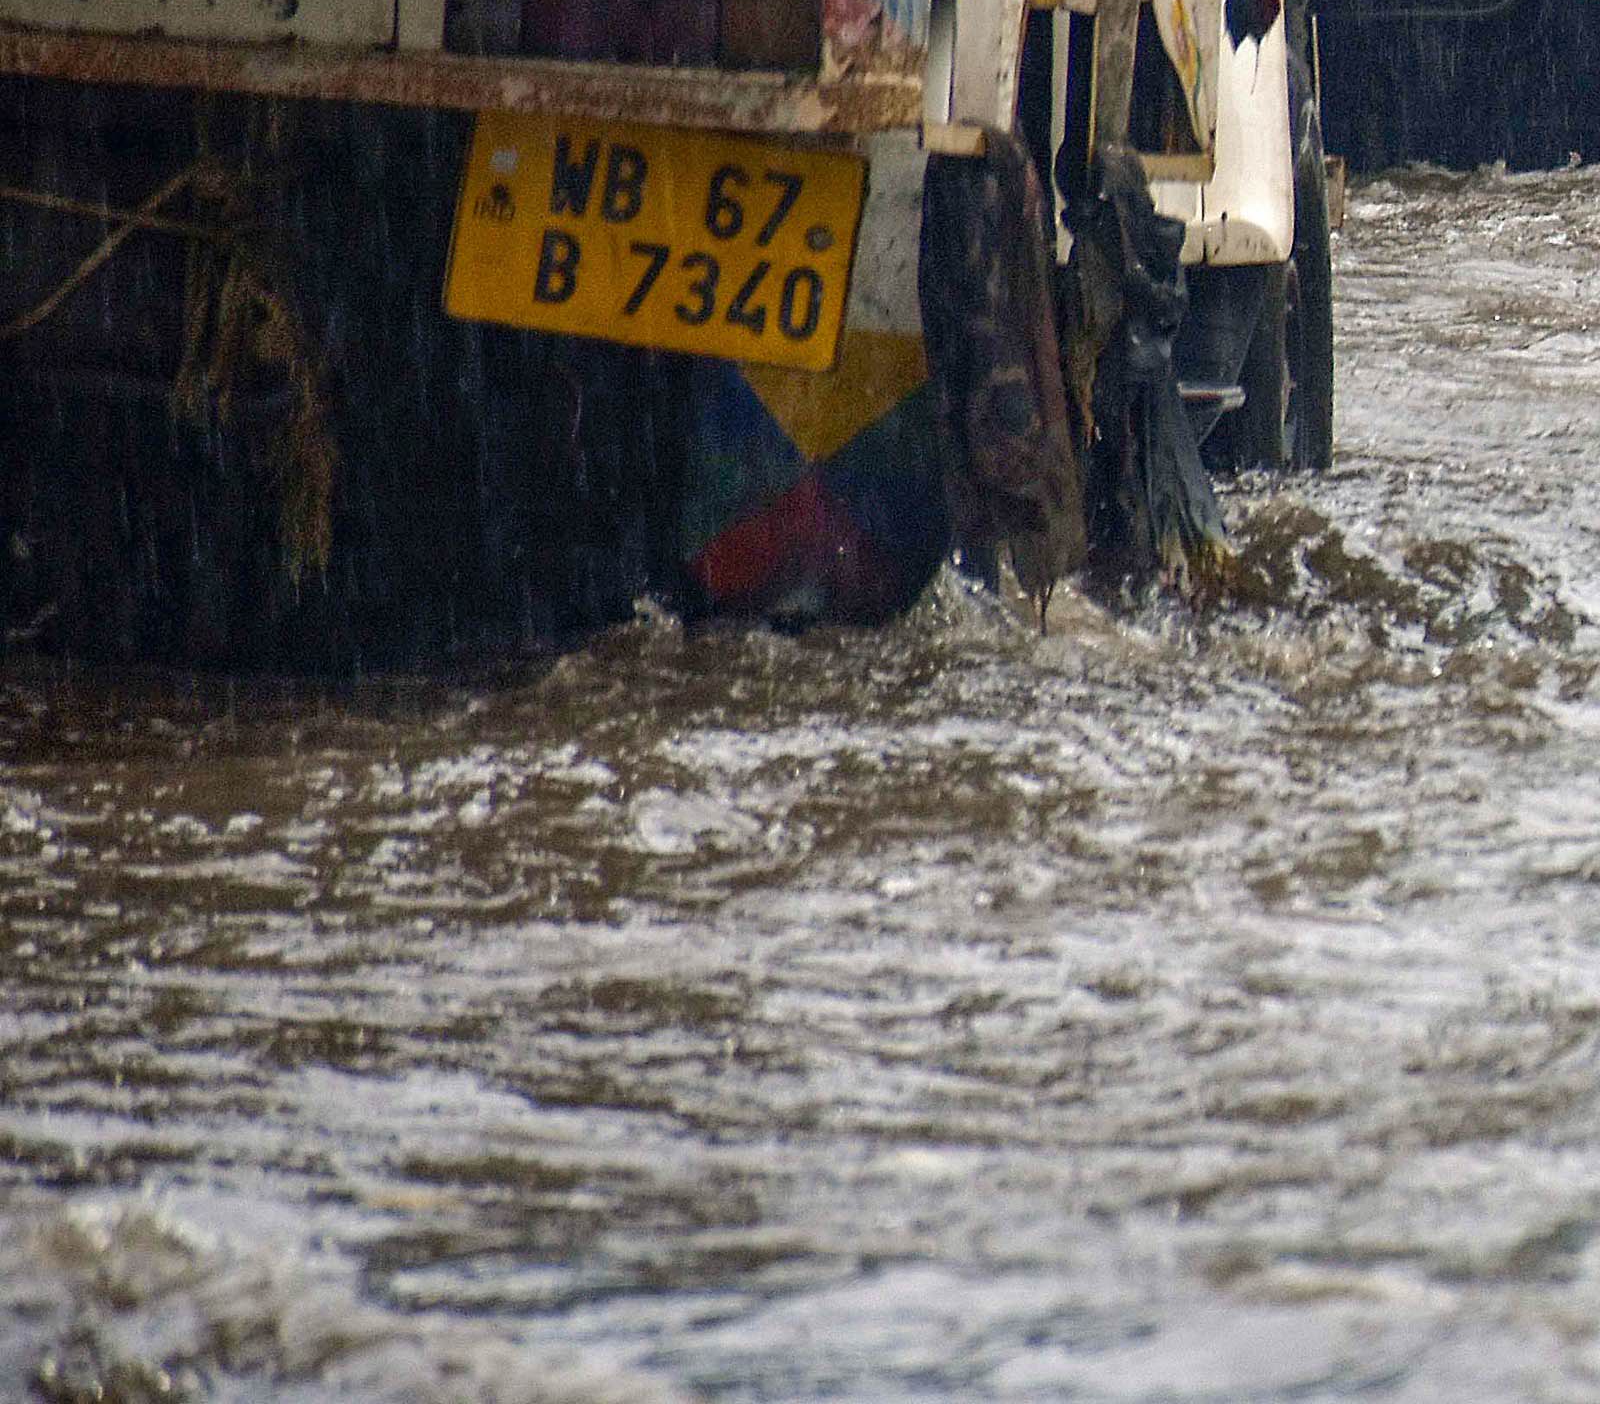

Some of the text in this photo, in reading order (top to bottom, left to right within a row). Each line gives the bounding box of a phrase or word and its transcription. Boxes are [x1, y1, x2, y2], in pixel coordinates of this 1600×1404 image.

[549, 131, 804, 247] WB 67
[532, 228, 824, 342] B 7340
